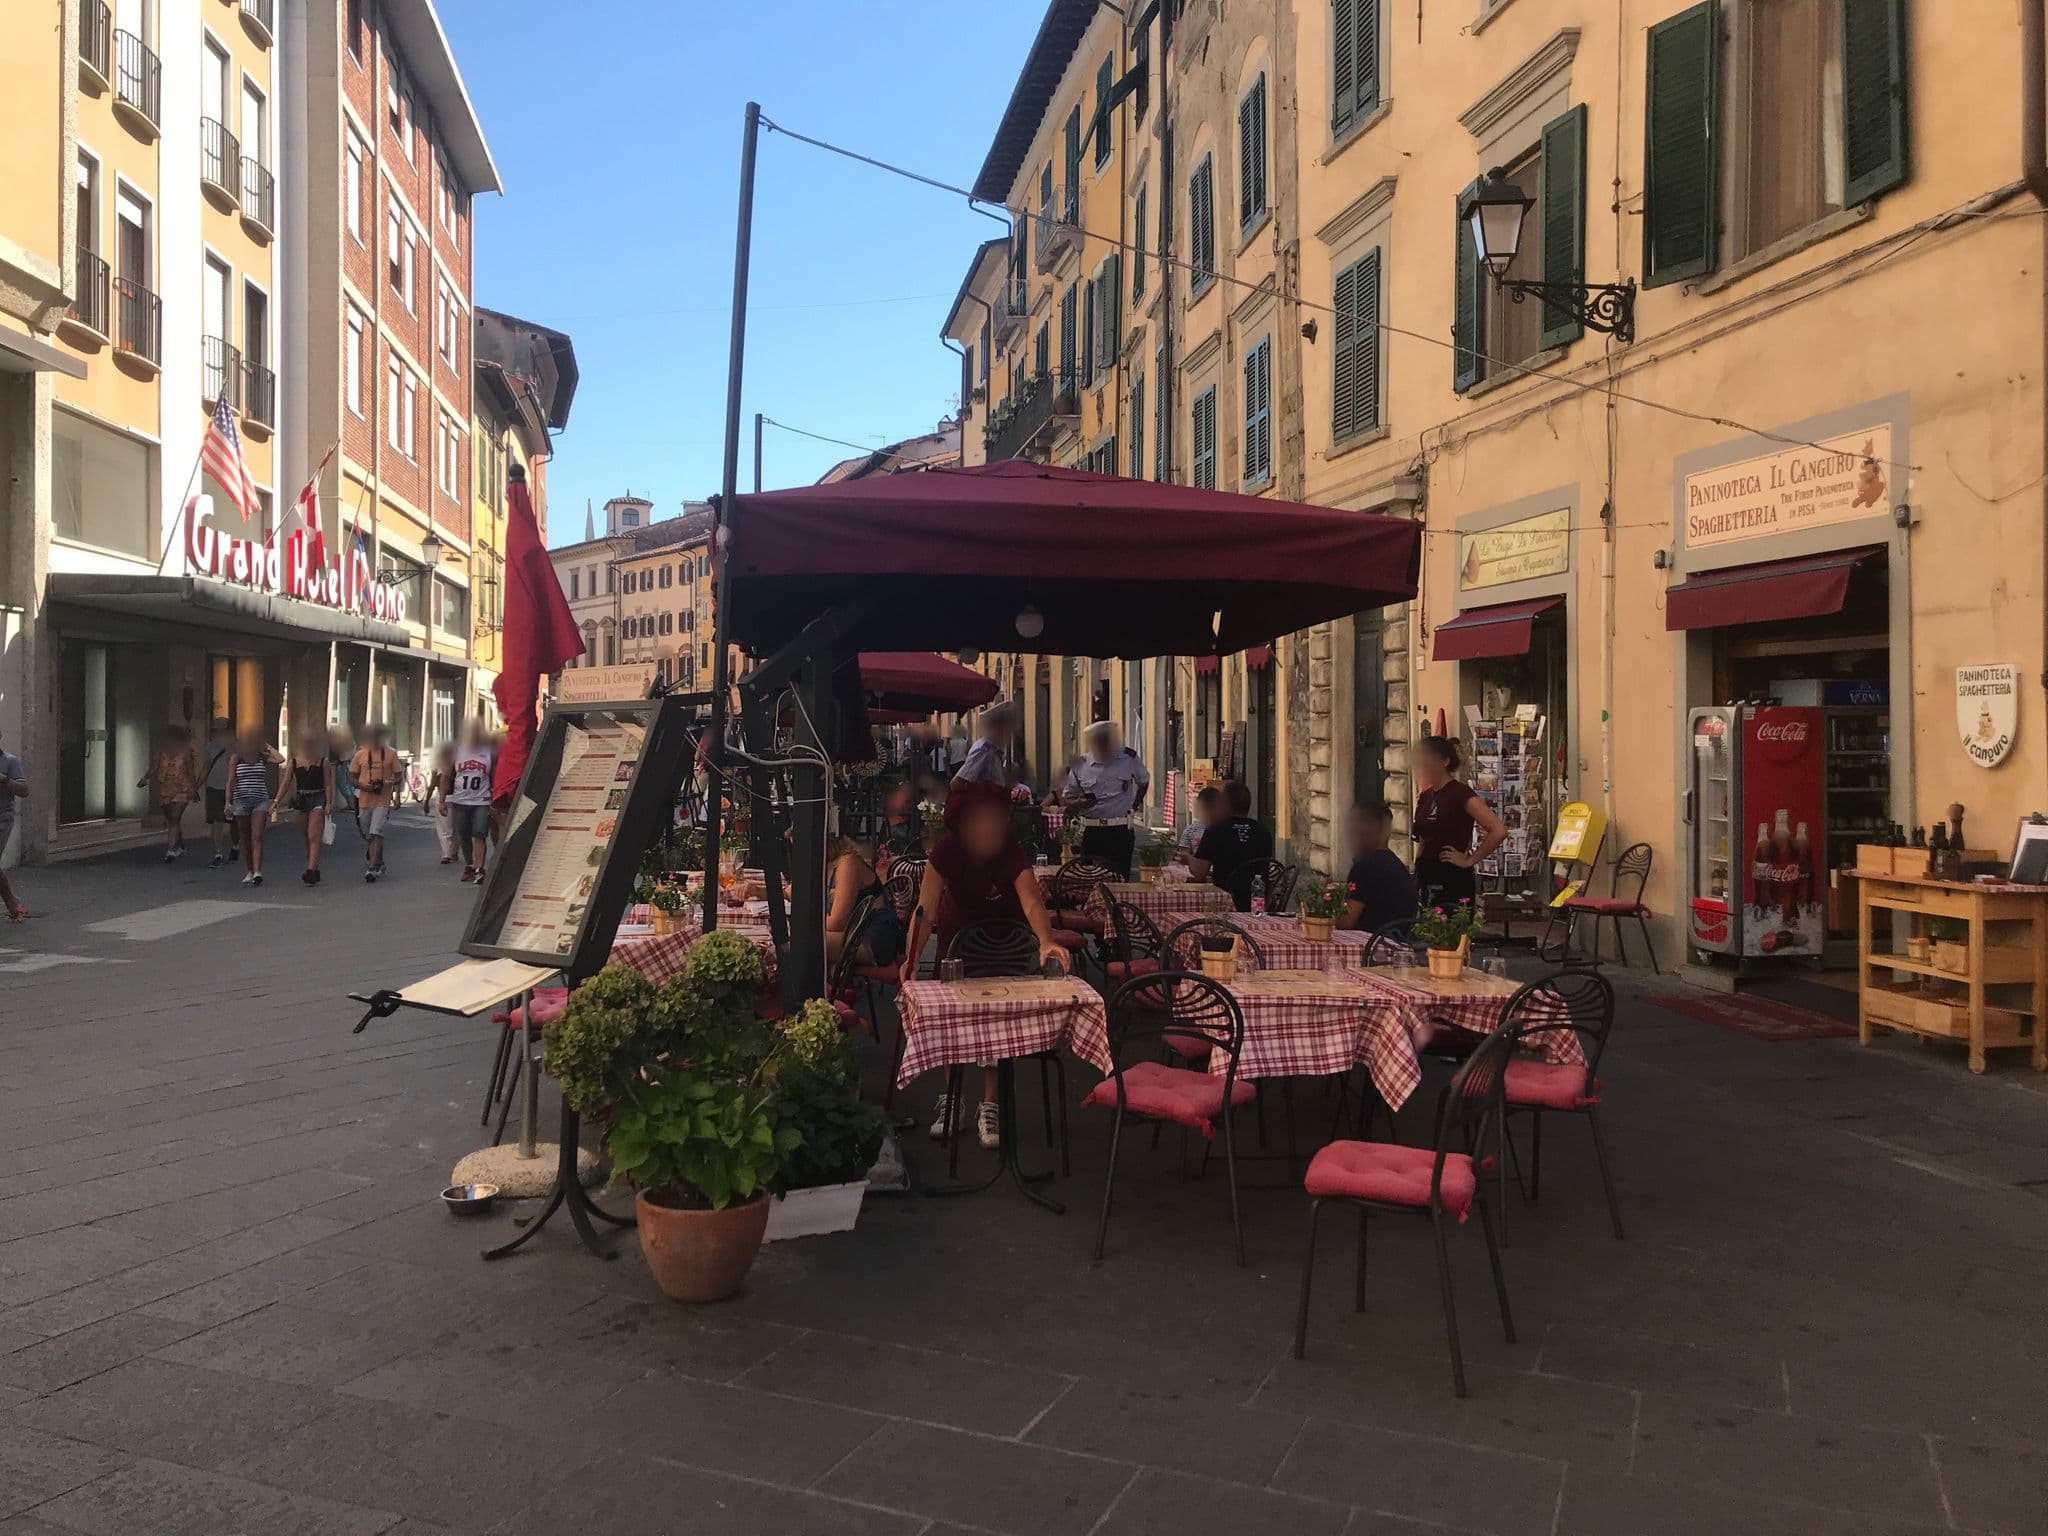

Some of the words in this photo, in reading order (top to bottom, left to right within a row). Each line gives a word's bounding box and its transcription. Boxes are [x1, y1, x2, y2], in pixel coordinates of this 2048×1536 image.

[1689, 475, 1761, 507] PANINOTECA
[1769, 465, 1784, 490] IL
[1790, 453, 1855, 484] CANGURO
[1798, 504, 1815, 517] PISA
[1689, 504, 1777, 538] SPAGHETTERIA
[1959, 668, 2011, 682] PANINOTECA
[1959, 684, 2011, 696] SPAGHETTERIA
[1970, 734, 2008, 762] canguro
[462, 775, 482, 790] 10
